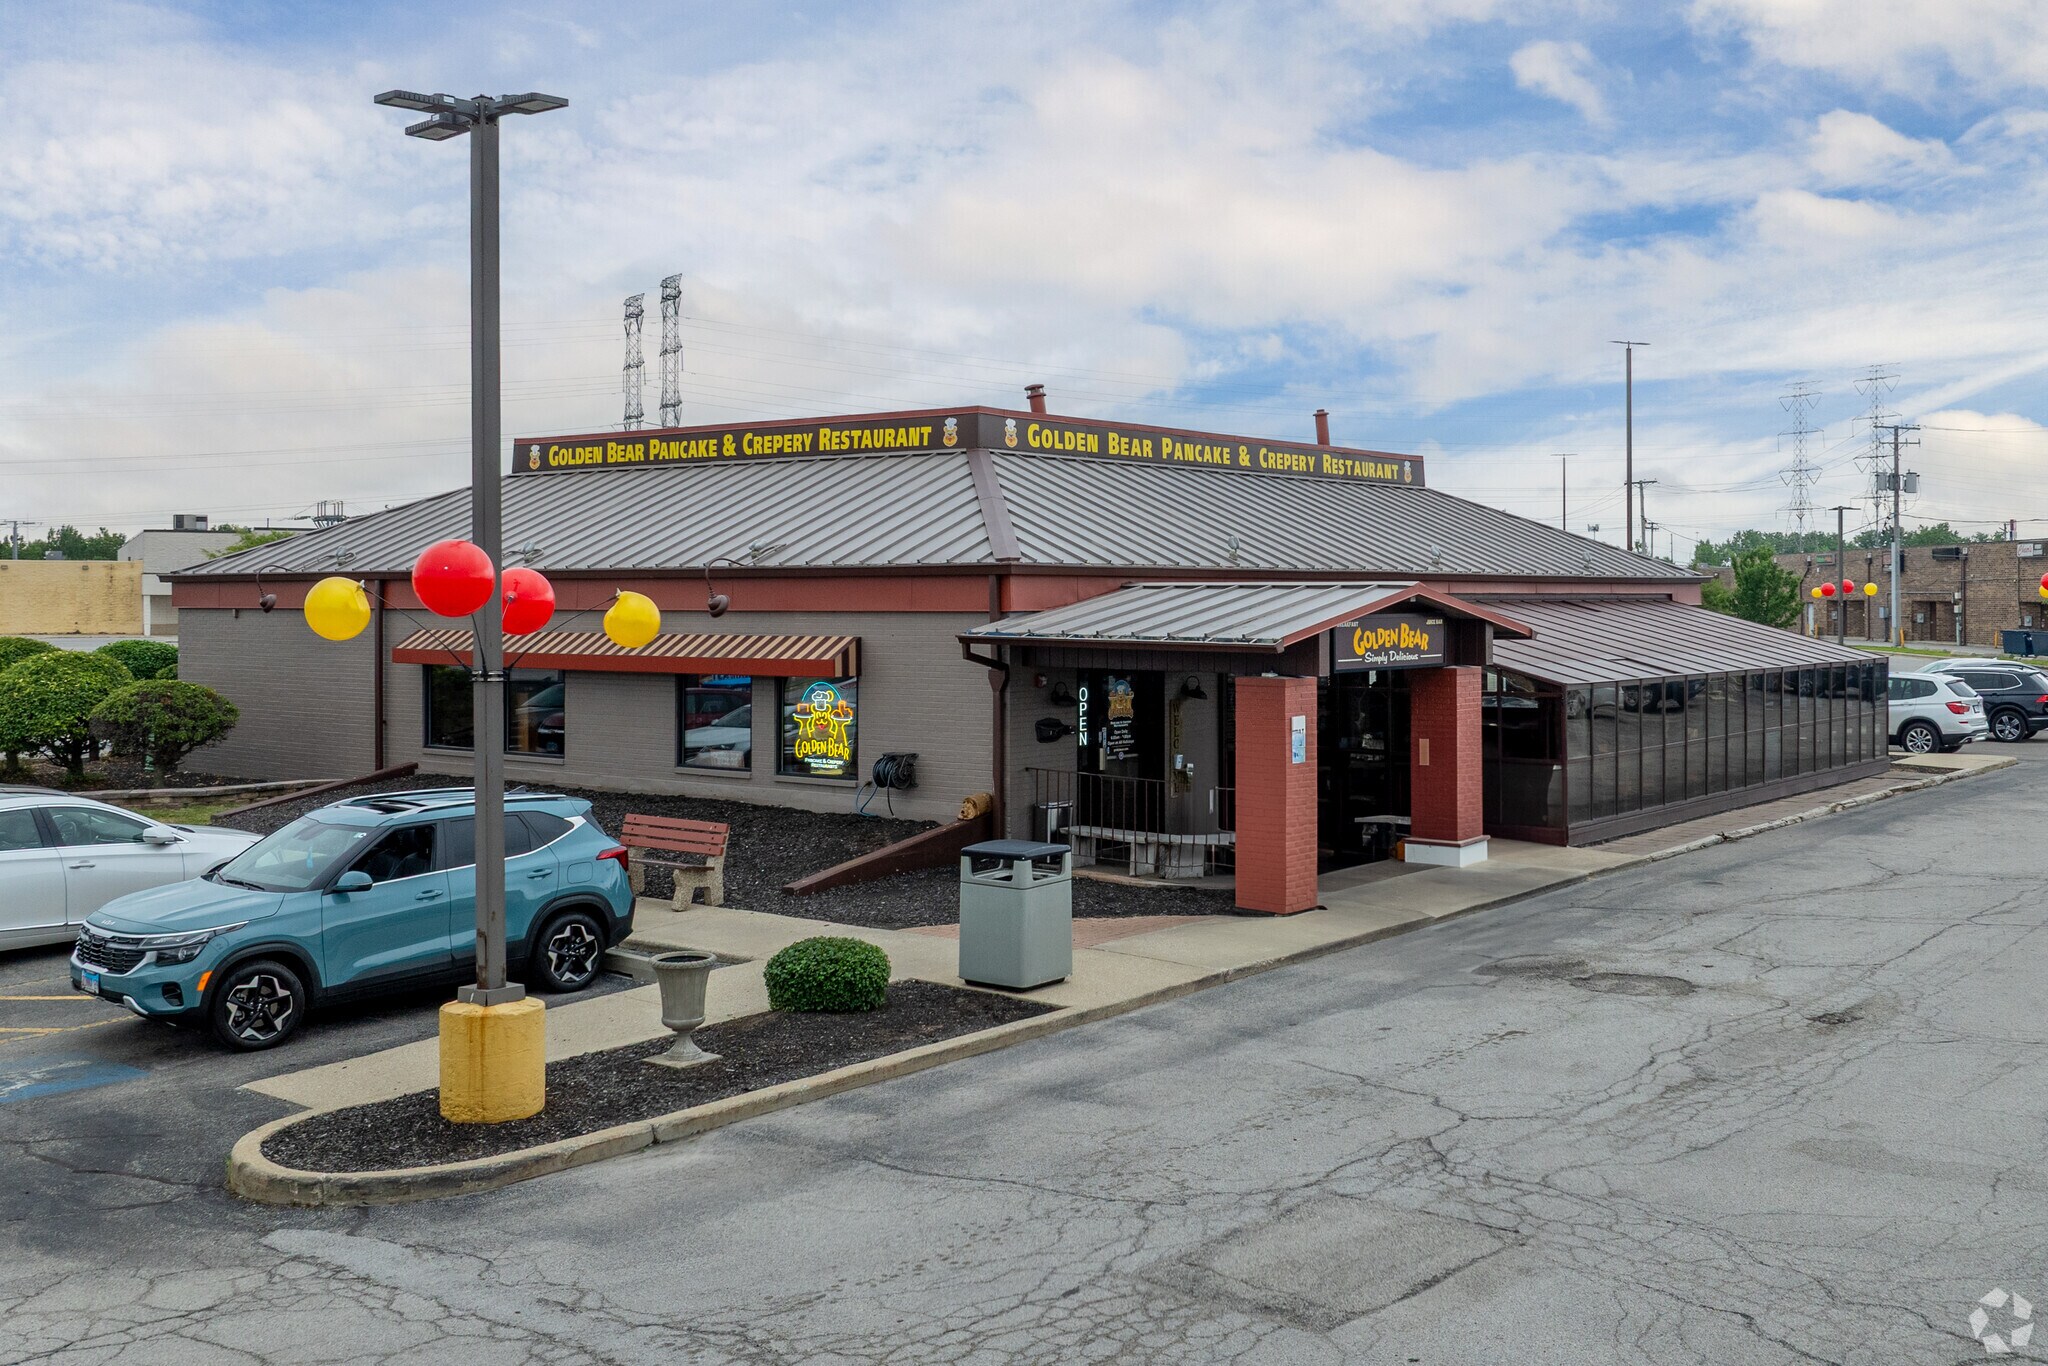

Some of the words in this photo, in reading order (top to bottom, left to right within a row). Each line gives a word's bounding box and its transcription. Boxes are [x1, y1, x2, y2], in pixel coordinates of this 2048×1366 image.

[548, 445, 603, 467] GOLDEN
[607, 440, 645, 464] BEAR
[649, 437, 718, 461] PANCAKE
[722, 432, 737, 456] &
[742, 432, 814, 456] CREPERY
[819, 425, 932, 452] RESTAURANT
[1028, 422, 1099, 453] GOLDEN
[1108, 431, 1153, 458] BEAR
[1162, 437, 1230, 465] PANCAKE
[1239, 445, 1251, 467] &
[1259, 447, 1316, 473] CREPERY
[1323, 454, 1399, 480] RESTAURANT
[1353, 627, 1399, 656] GOLDEN
[1400, 622, 1430, 651] BEAR
[1364, 651, 1388, 665] Simply
[1389, 650, 1419, 662] Delicious
[1079, 687, 1088, 746] OPEN
[795, 738, 828, 758] GOLDEN
[828, 737, 850, 761] BEAR
